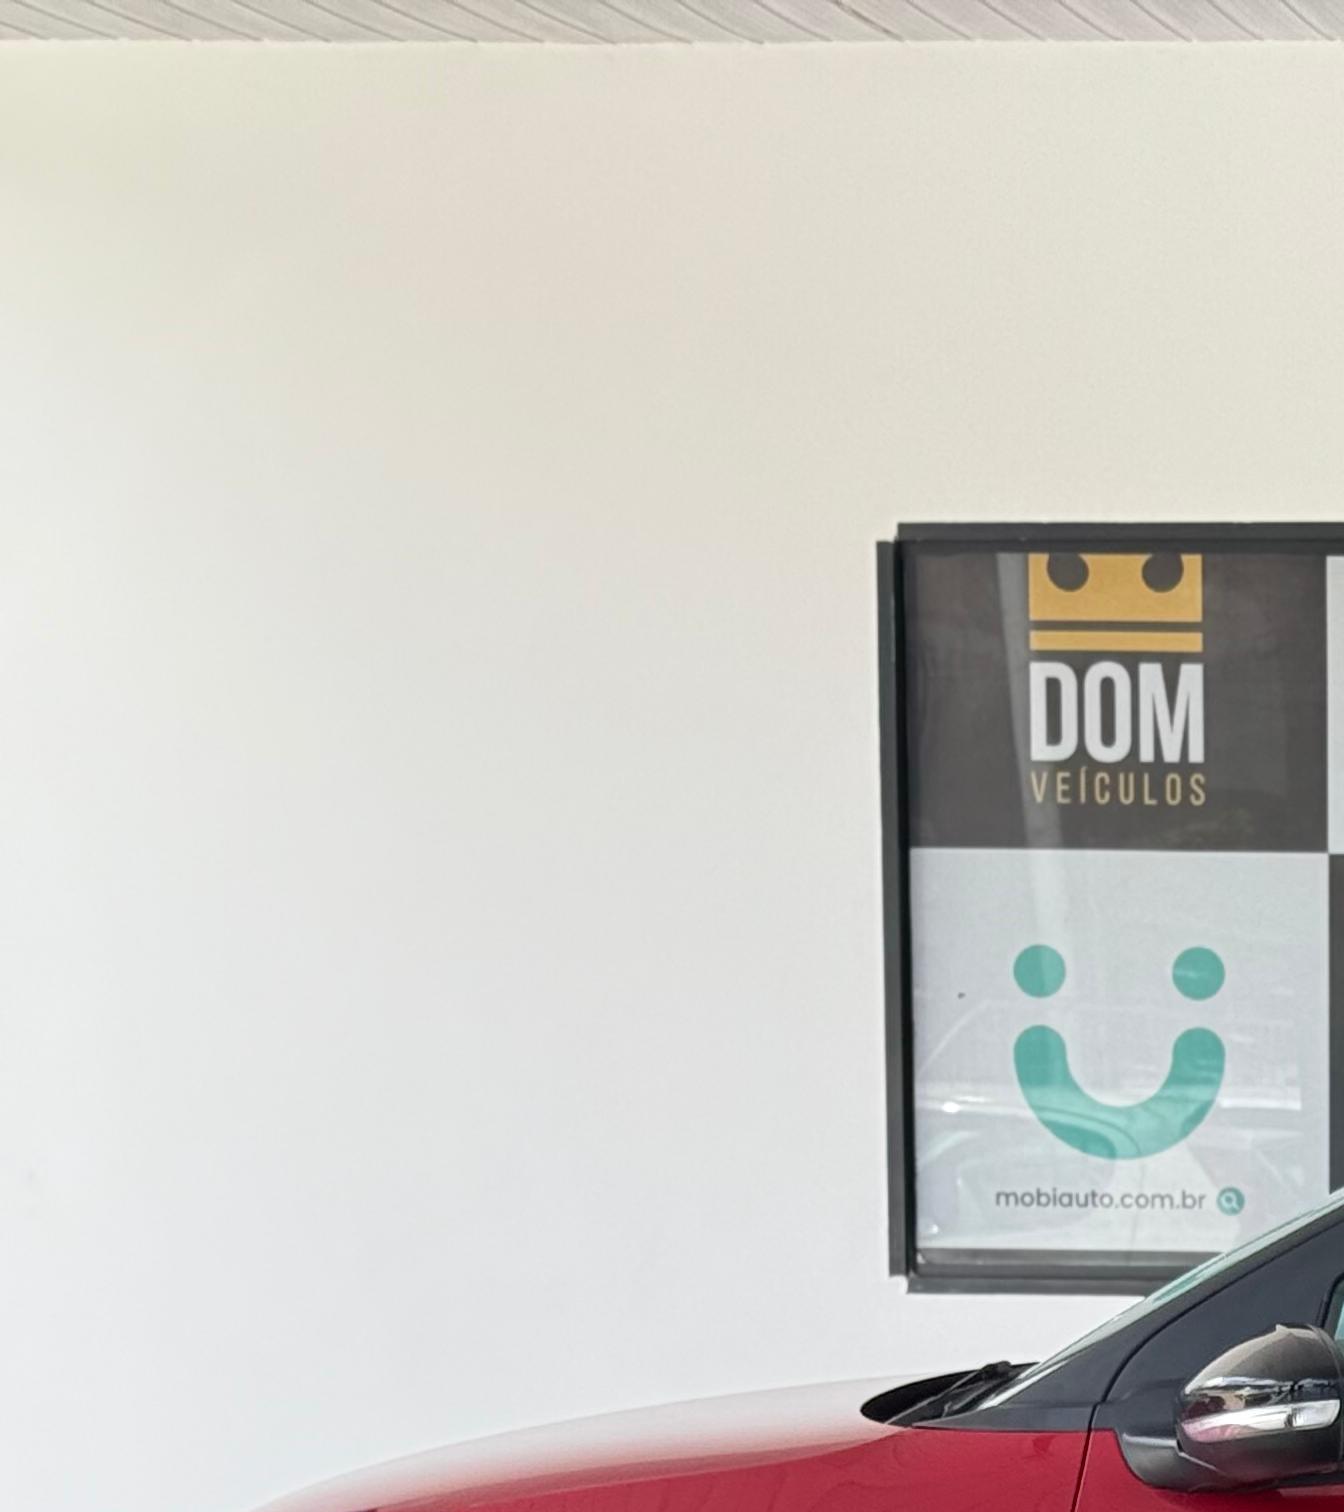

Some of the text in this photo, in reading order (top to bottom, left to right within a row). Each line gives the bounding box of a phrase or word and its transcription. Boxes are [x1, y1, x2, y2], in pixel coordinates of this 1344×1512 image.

[1029, 661, 1205, 763] DOM
[1030, 766, 1207, 806] VEÍCULOS
[995, 1187, 1206, 1210] mobiauto.com.br
